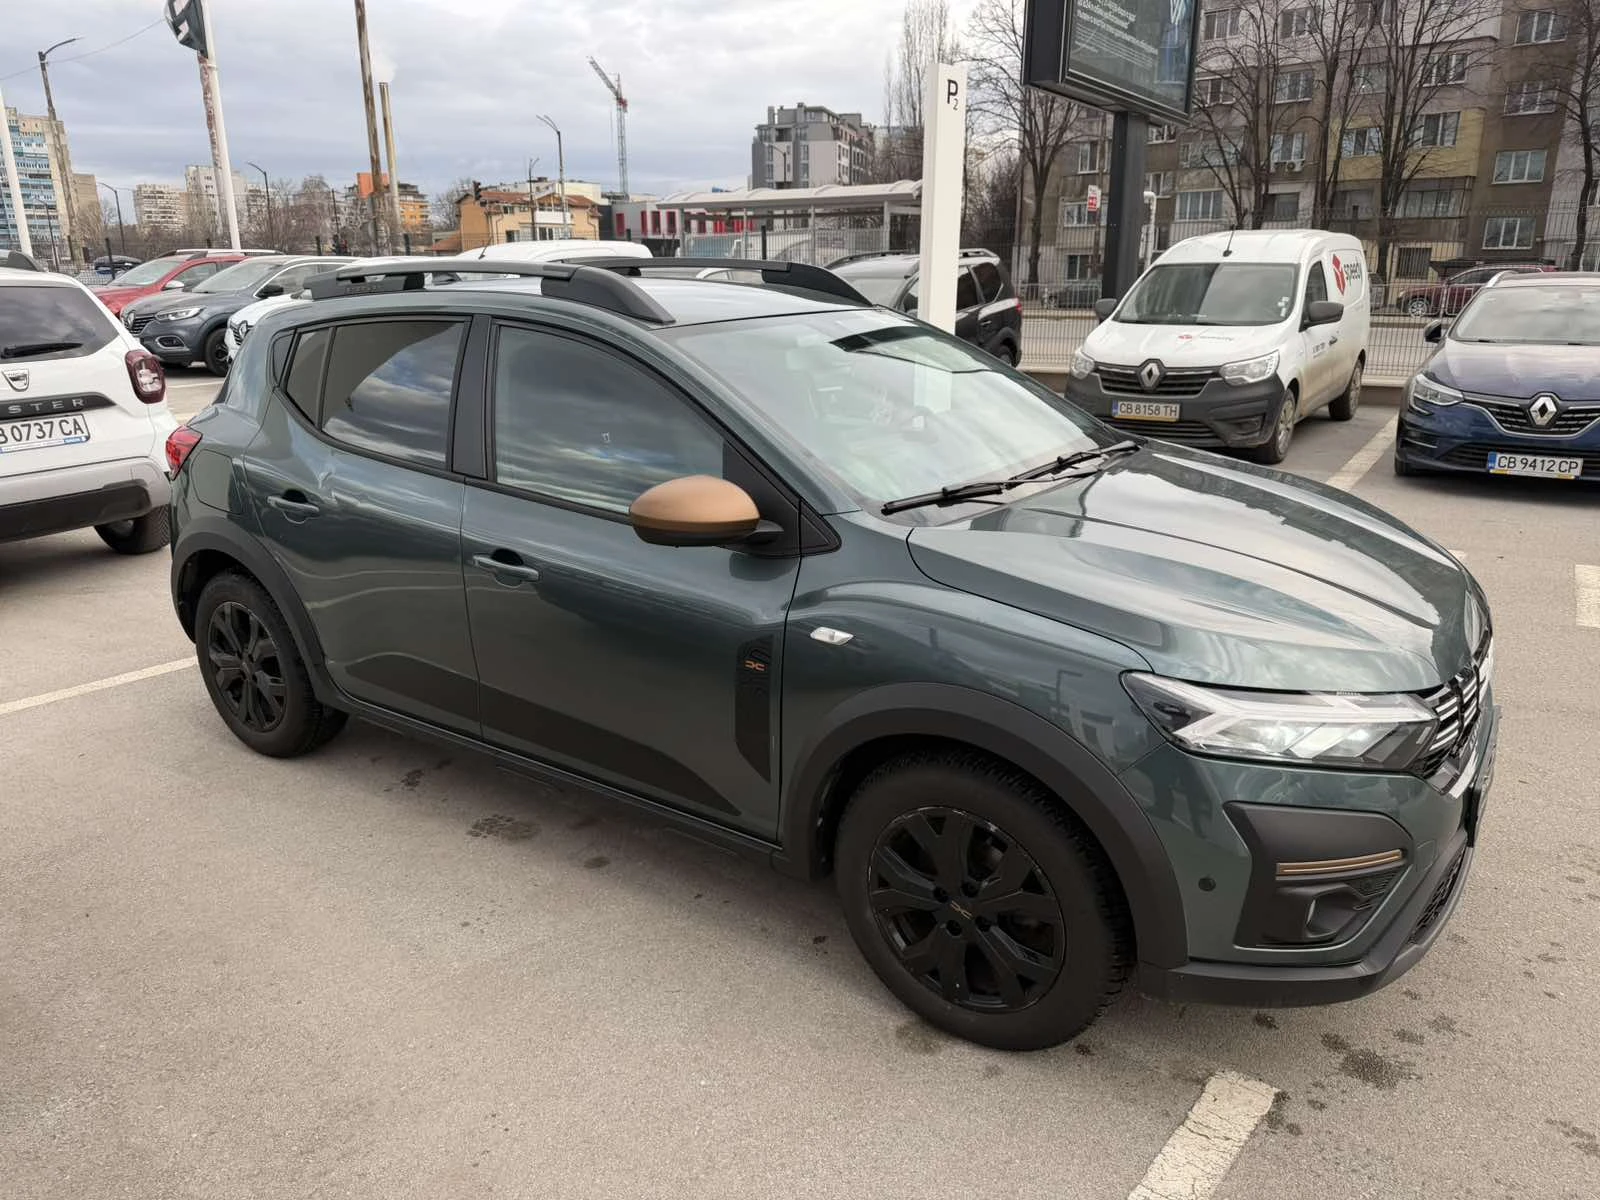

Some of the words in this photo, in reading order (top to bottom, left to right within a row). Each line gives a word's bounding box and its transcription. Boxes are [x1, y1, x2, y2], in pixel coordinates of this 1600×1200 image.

[7, 398, 84, 414] STER
[1120, 402, 1133, 415] CB
[1135, 404, 1161, 416] 8158
[1163, 405, 1178, 417] TH
[10, 420, 55, 442] 0737
[58, 418, 84, 436] CA
[1498, 455, 1517, 469] CB
[1520, 457, 1556, 472] 9412
[1558, 460, 1579, 473] CP
